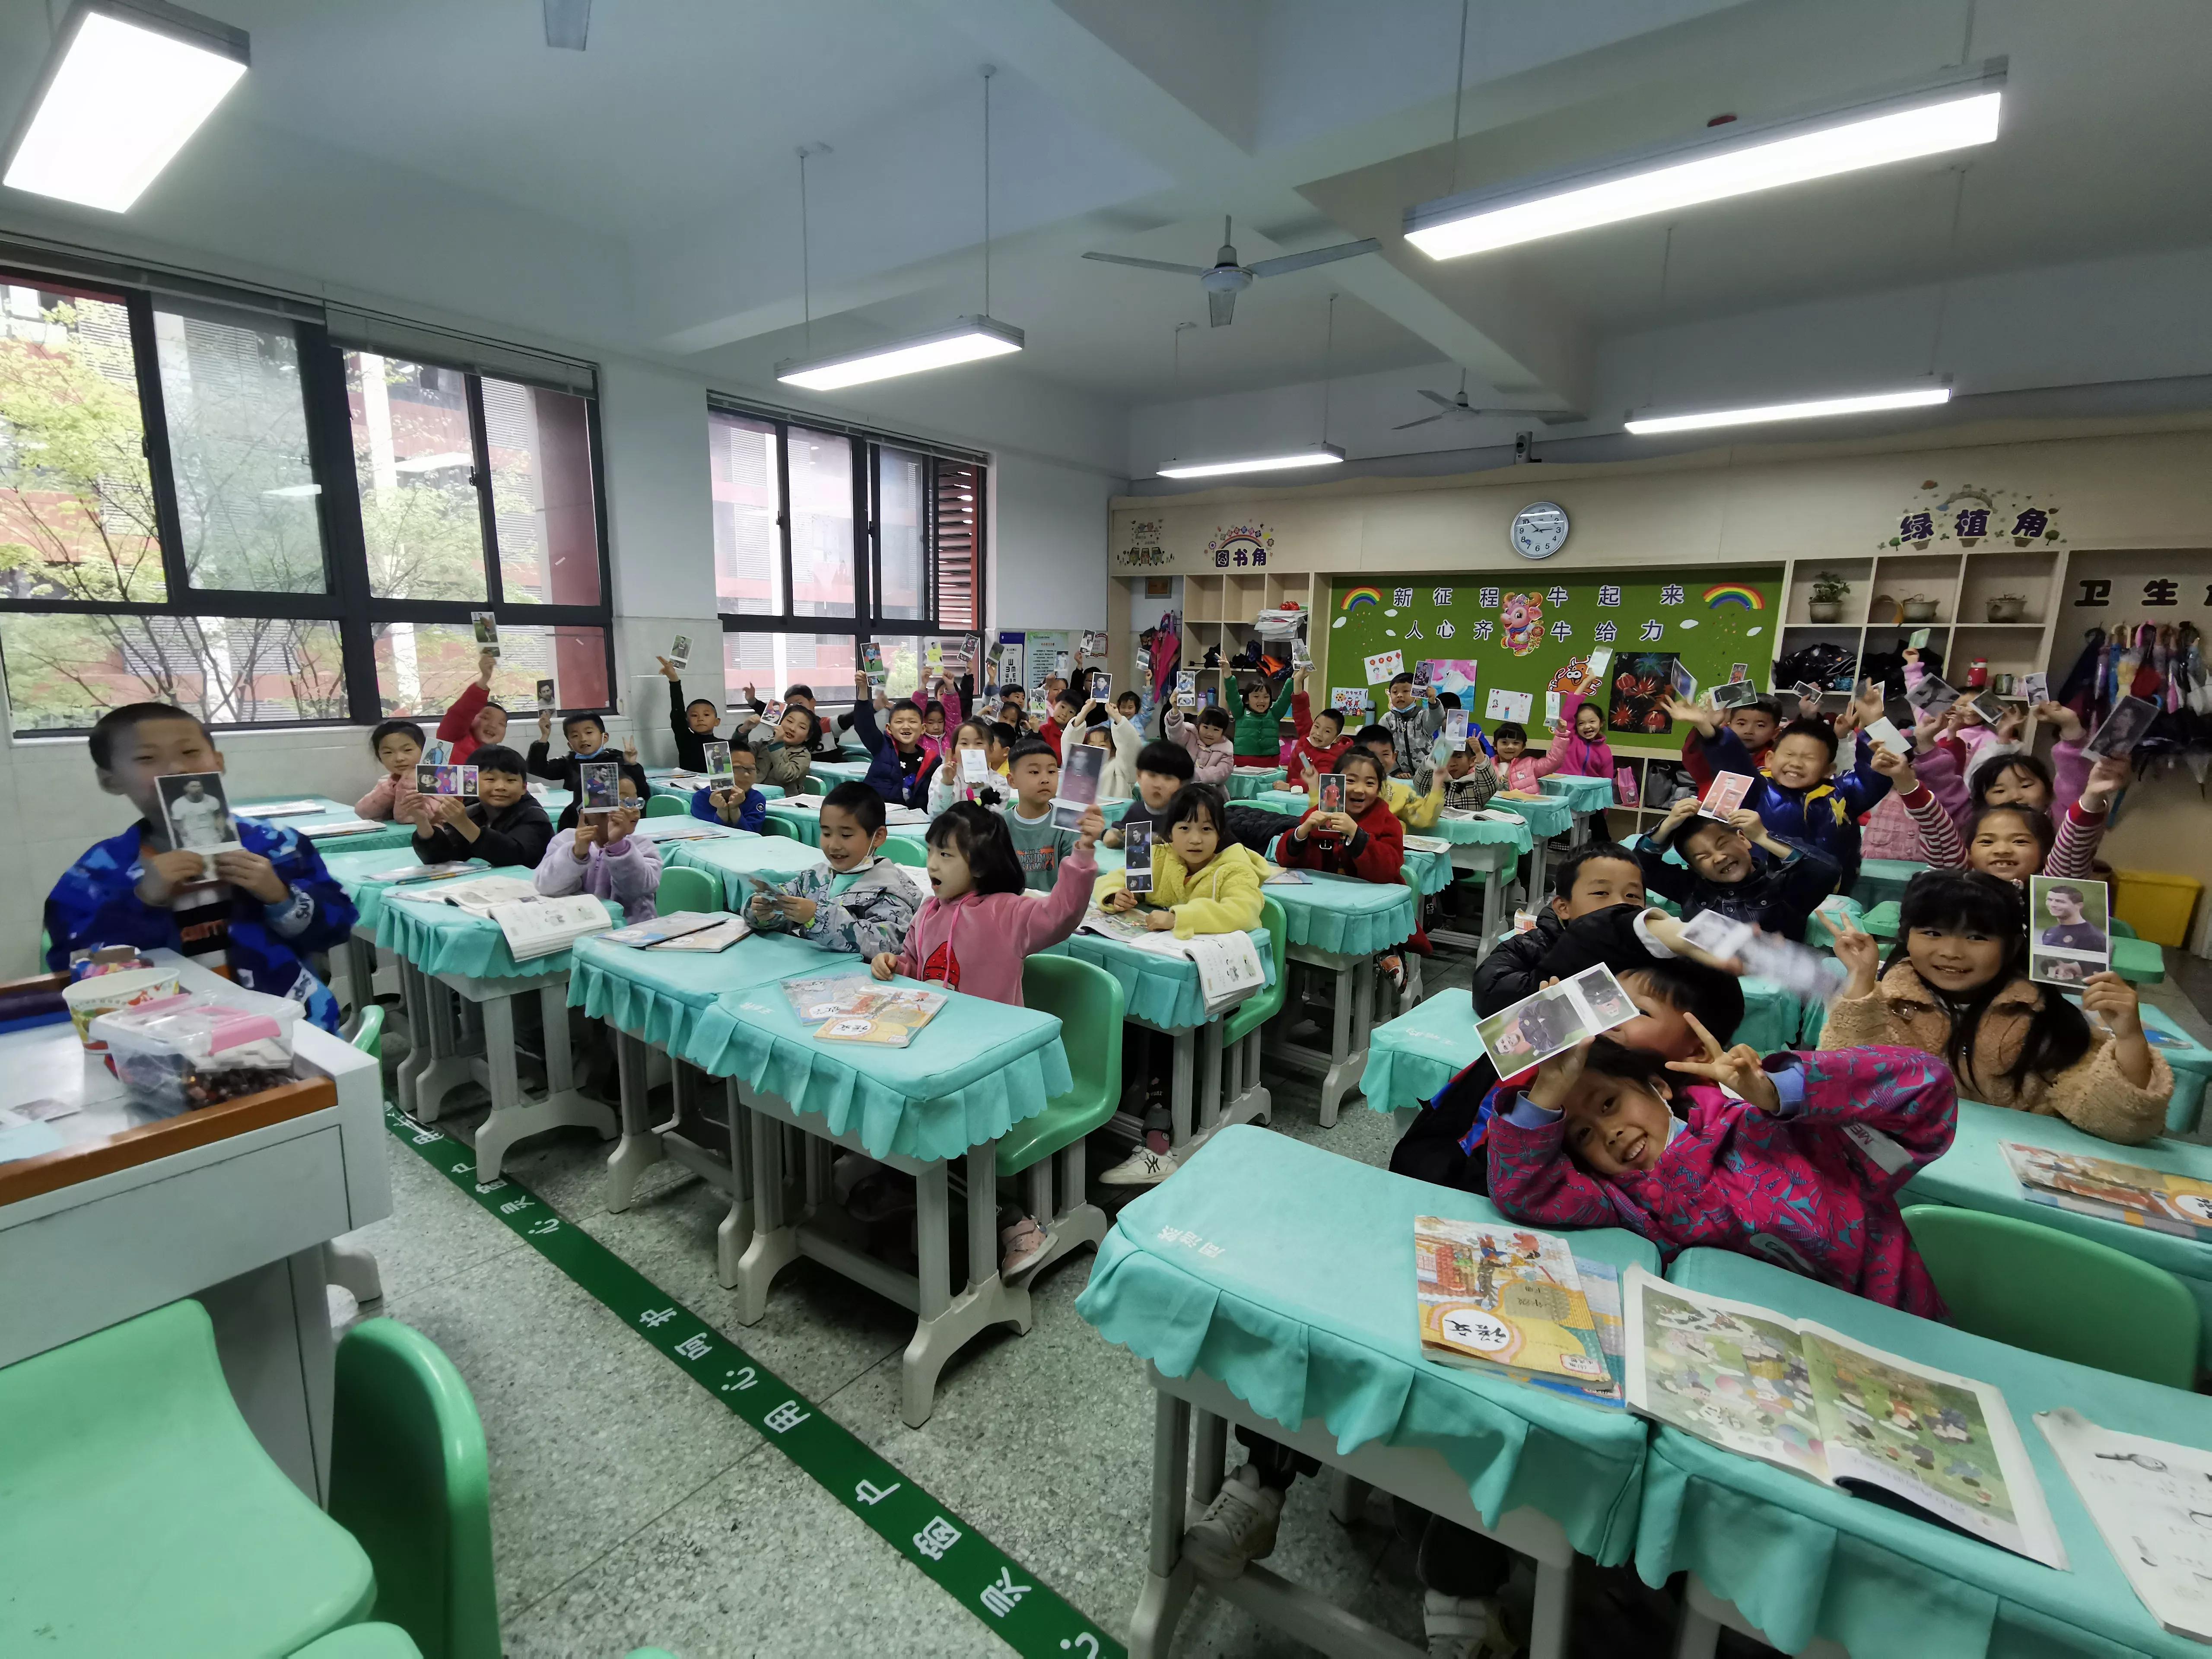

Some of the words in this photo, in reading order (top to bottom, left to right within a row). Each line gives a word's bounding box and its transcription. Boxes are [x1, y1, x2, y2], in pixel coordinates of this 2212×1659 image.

[1901, 508, 2048, 542] 绿植角
[1215, 548, 1267, 568] 图书角
[1393, 587, 1500, 607] 新征程
[1547, 584, 1684, 608] 牛起来
[2074, 578, 2212, 606] 卫生
[1405, 619, 1494, 641] 人心齐
[1550, 619, 1664, 642] 牛给力
[1444, 1319, 1506, 1344] 语文
[638, 1307, 811, 1433] 用心呵护
